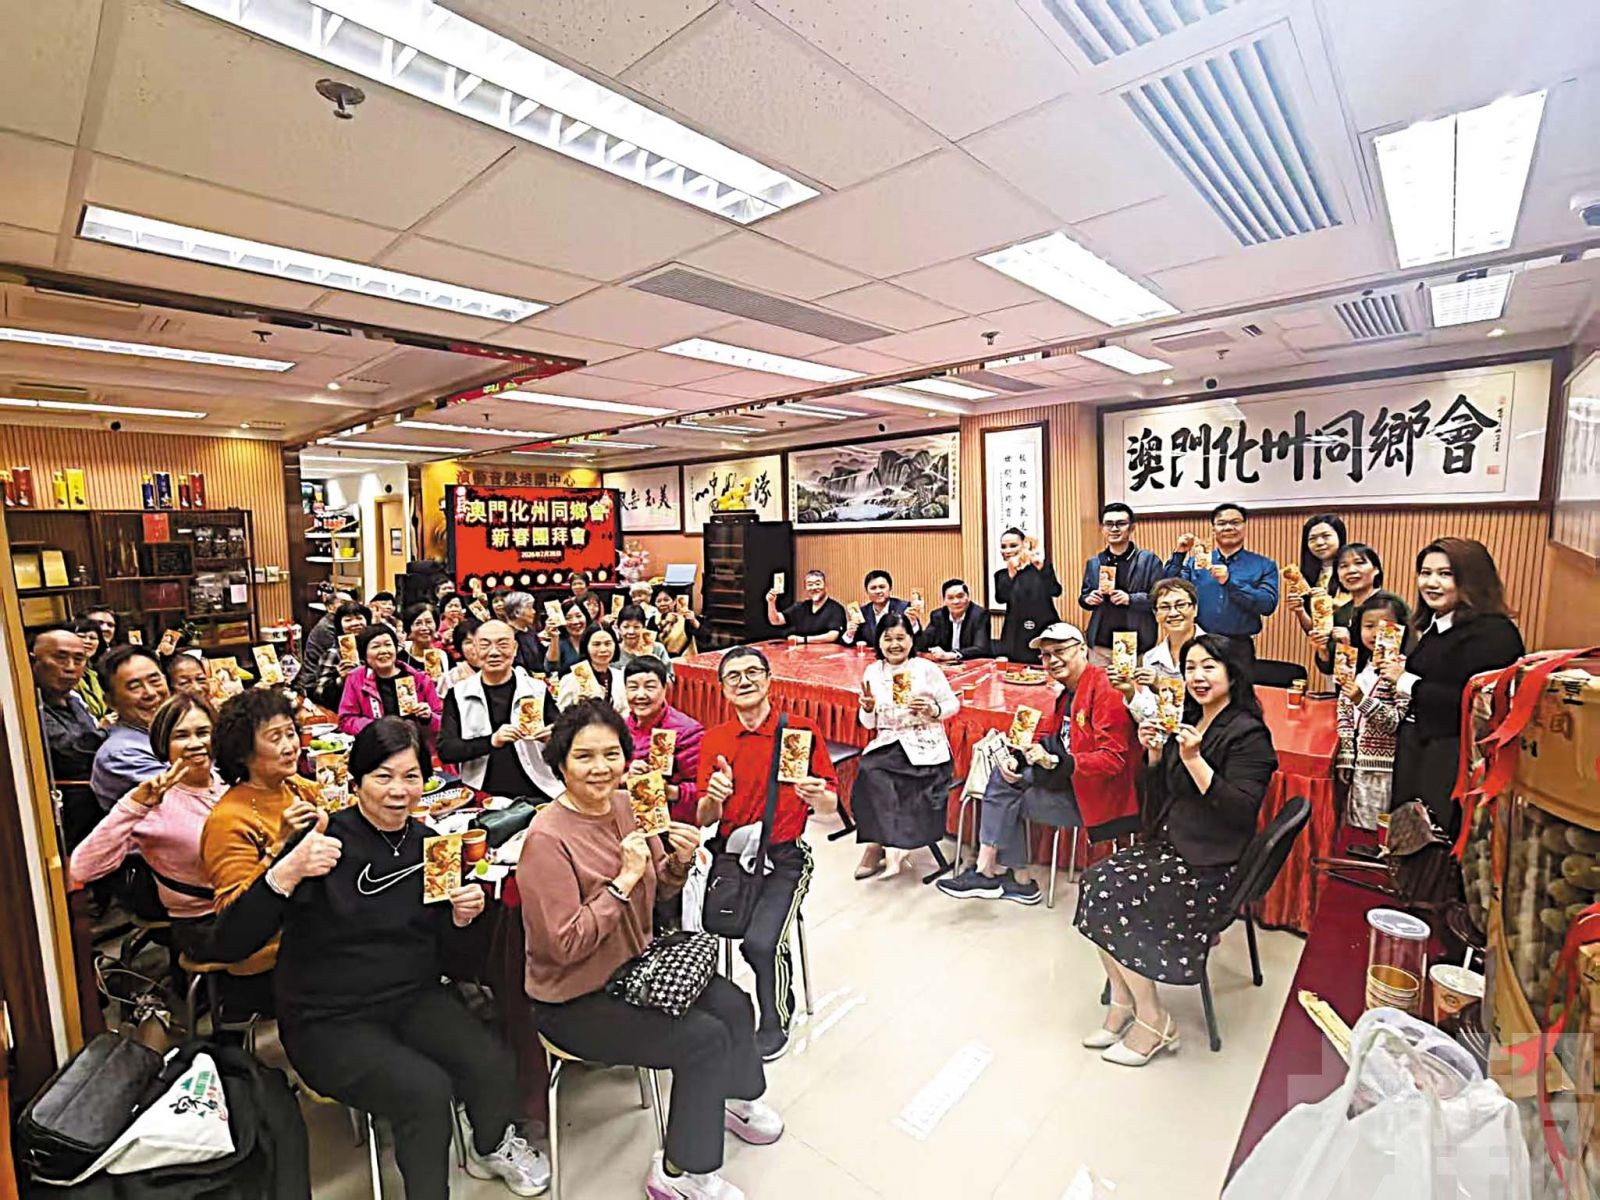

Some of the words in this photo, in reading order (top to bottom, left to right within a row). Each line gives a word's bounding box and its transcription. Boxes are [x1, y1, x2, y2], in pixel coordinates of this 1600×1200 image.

[1126, 394, 1499, 491] 澳門化州同鄉會
[465, 500, 606, 523] 澳門化州同鄉會
[491, 527, 586, 548] 新春團拜會
